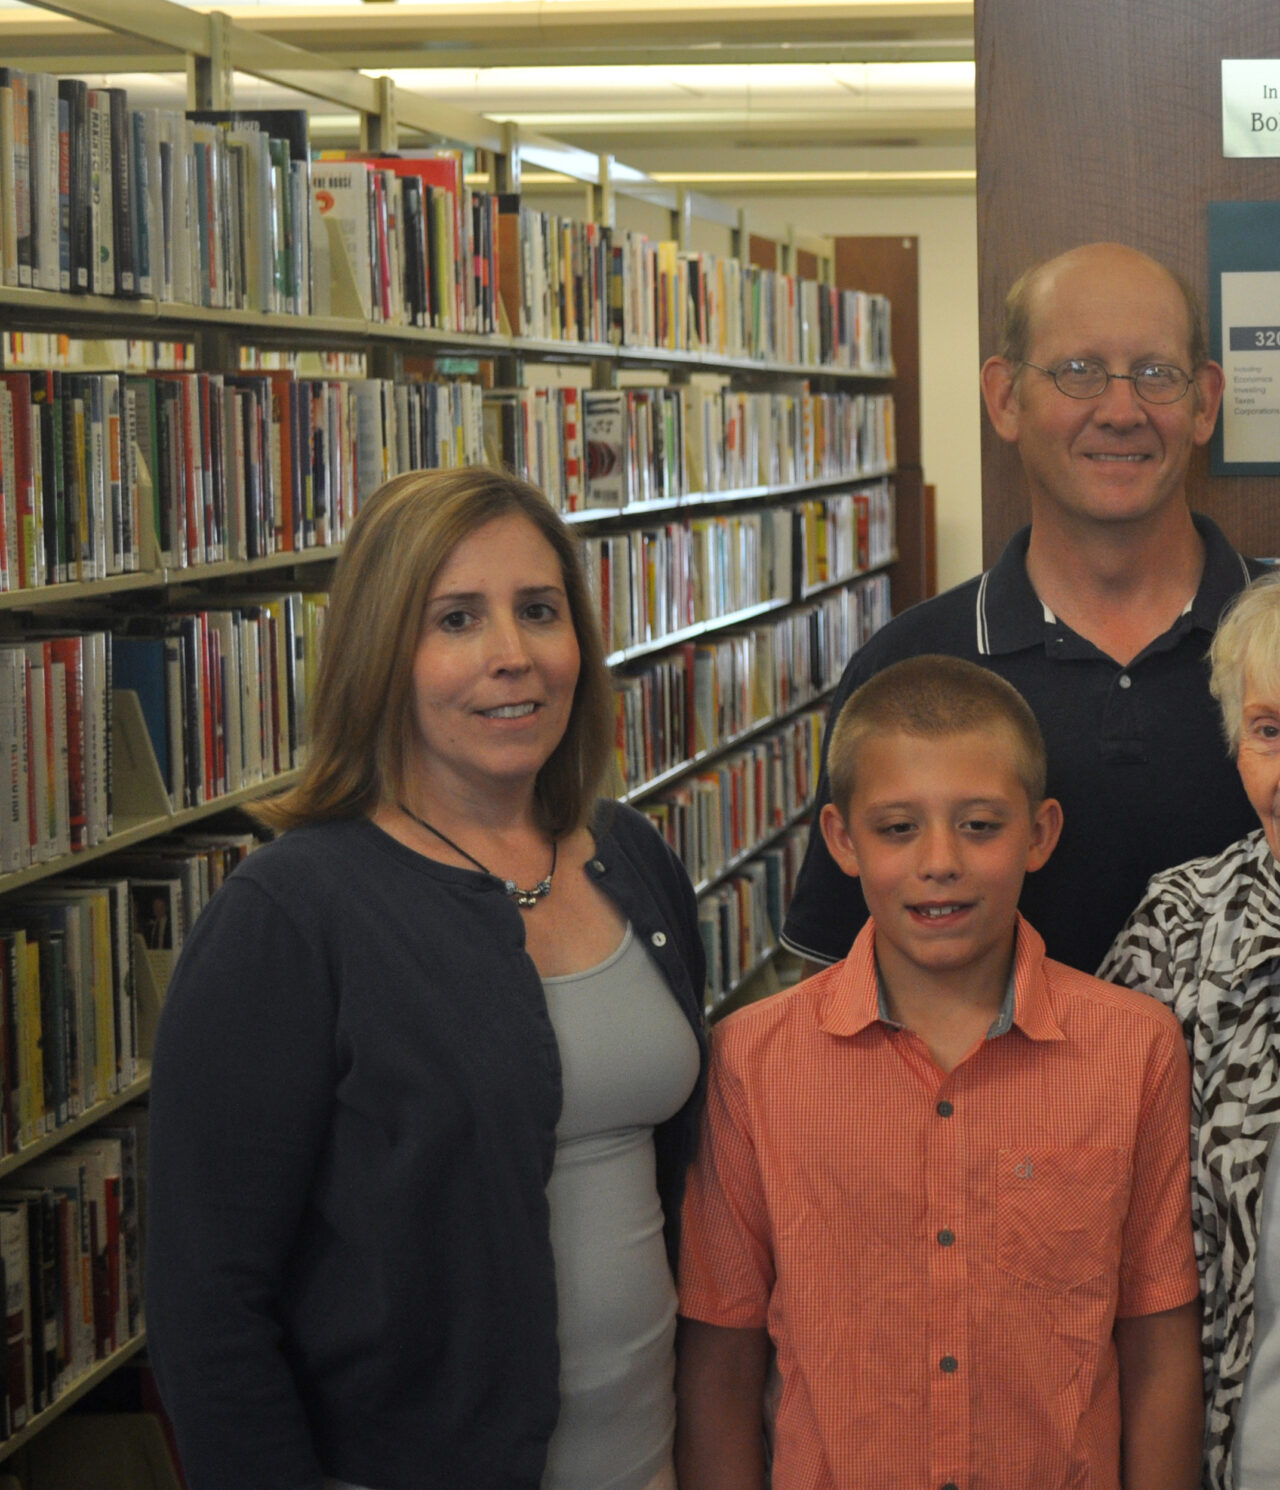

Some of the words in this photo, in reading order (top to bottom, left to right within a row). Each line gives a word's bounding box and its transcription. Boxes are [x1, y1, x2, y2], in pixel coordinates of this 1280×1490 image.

[1262, 84, 1278, 99] In
[1233, 375, 1273, 383] Economics
[1233, 386, 1267, 395] Investing
[1234, 407, 1280, 416] Corporations
